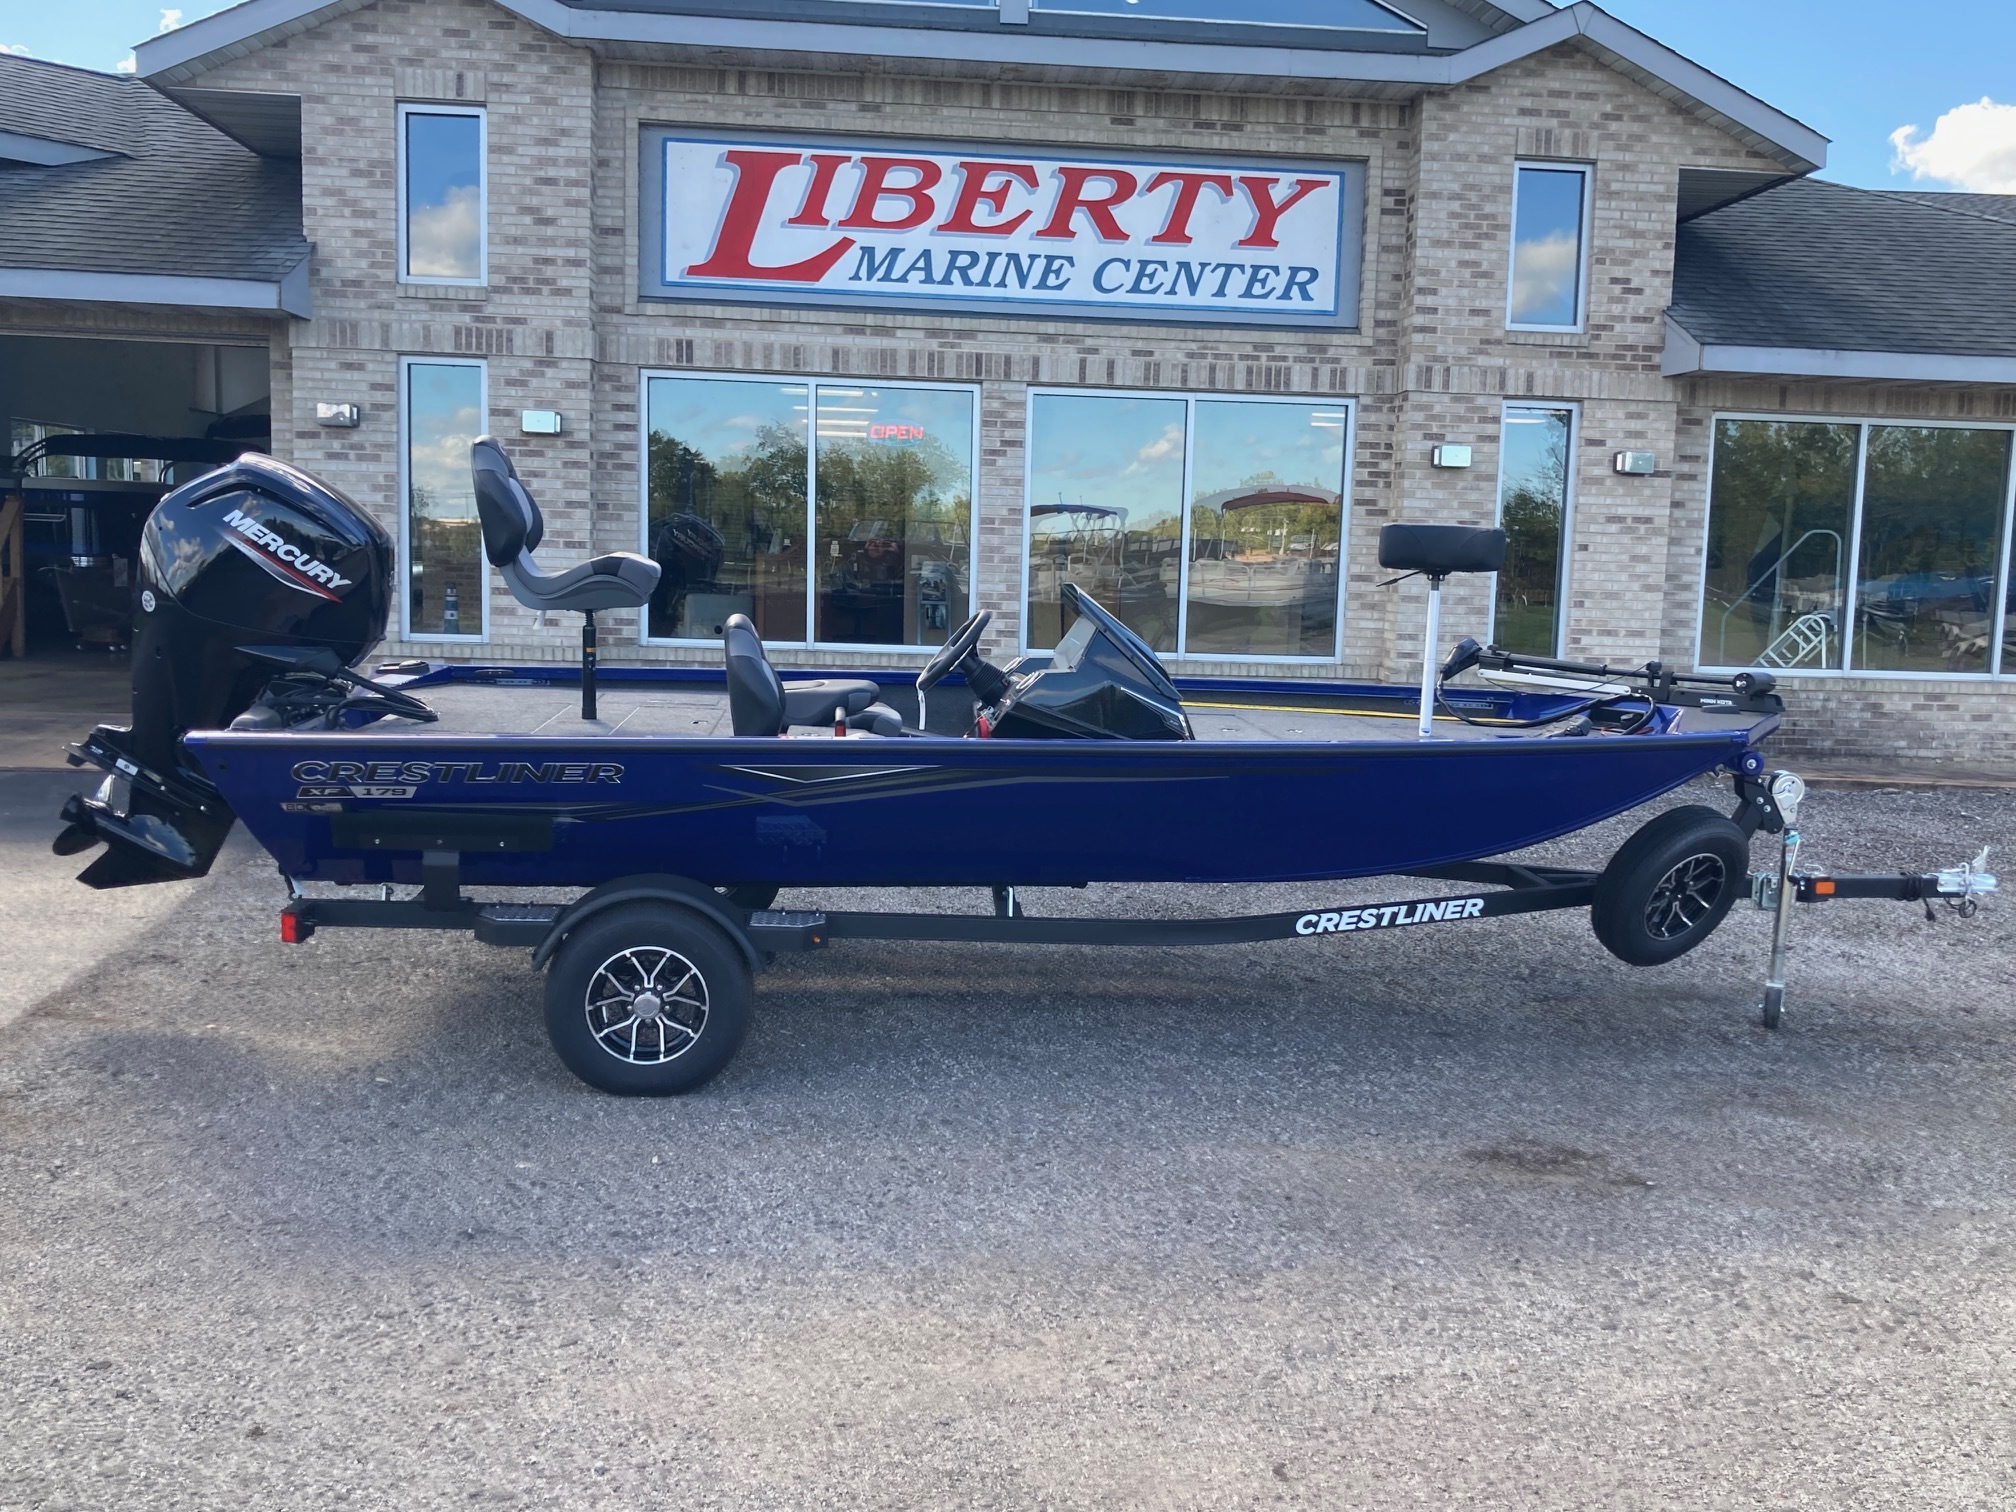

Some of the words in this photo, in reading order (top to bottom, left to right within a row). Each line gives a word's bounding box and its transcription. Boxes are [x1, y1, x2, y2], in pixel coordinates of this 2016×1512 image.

[683, 149, 1331, 284] LIBERTY
[848, 245, 1076, 292] MARINE
[1092, 256, 1320, 302] CENTER
[869, 424, 924, 440] OPEN
[222, 509, 353, 589] MERCURY
[291, 760, 625, 784] CRESTLINER
[308, 788, 341, 796] XF
[362, 787, 407, 796] 179
[1295, 898, 1485, 935] CRESTLINER
